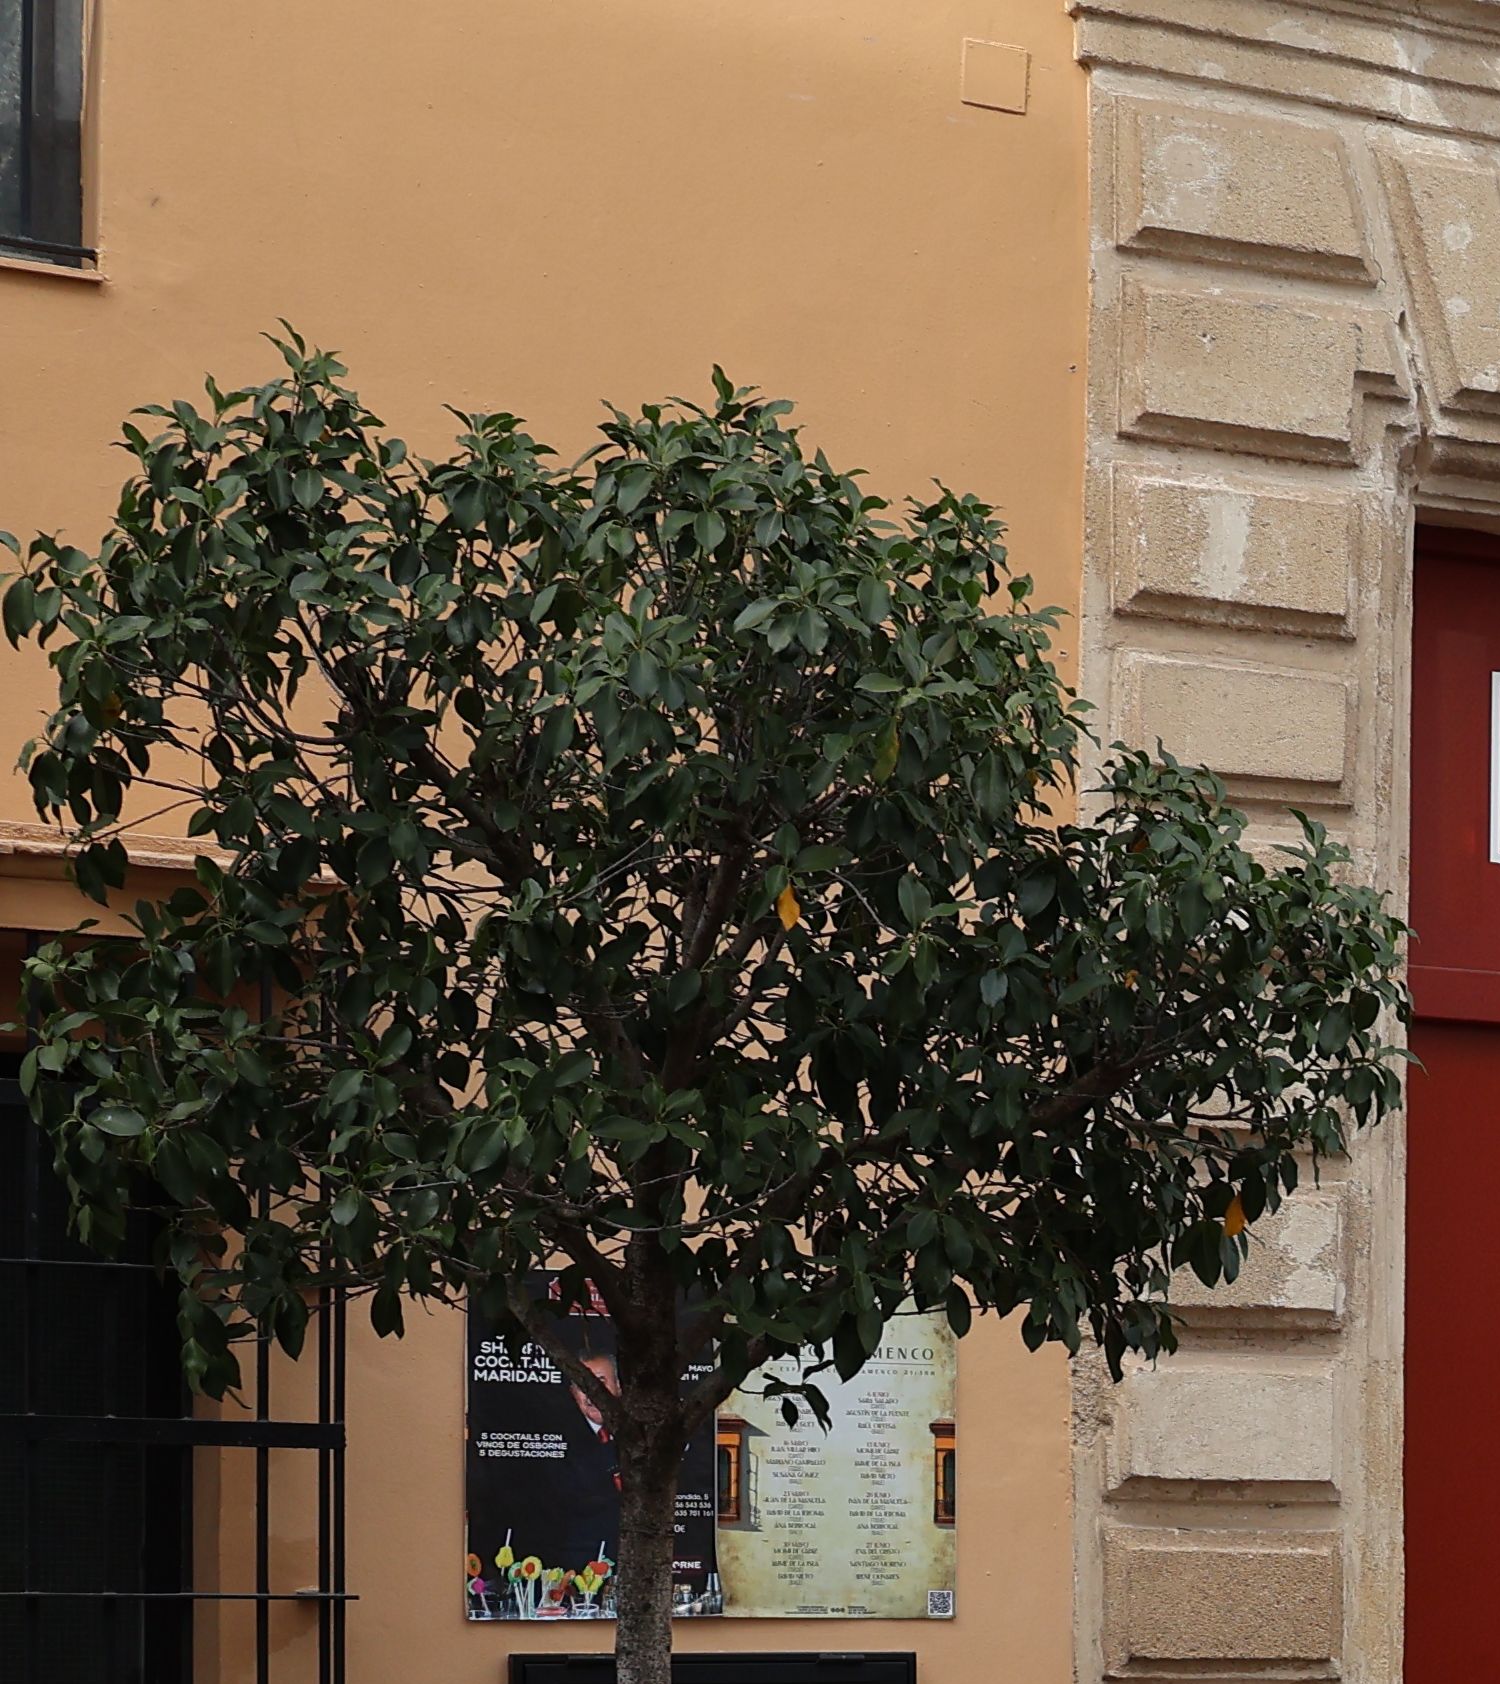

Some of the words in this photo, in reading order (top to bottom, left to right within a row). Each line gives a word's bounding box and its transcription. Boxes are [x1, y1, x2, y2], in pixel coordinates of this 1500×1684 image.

[871, 1346, 935, 1361] MENCO
[474, 1355, 556, 1370] COCTAIL
[688, 1365, 714, 1373] MAYO
[474, 1369, 562, 1384] MARIDAJE
[691, 1373, 699, 1381] H
[481, 1432, 488, 1440] 5
[490, 1432, 541, 1441] COCKTAILS
[542, 1433, 563, 1441] CON
[476, 1441, 505, 1449] VINOS
[507, 1441, 521, 1449] DE
[522, 1442, 568, 1450] OSBORNE
[479, 1449, 486, 1457] 5
[488, 1449, 565, 1458] DEGUSTACIONES
